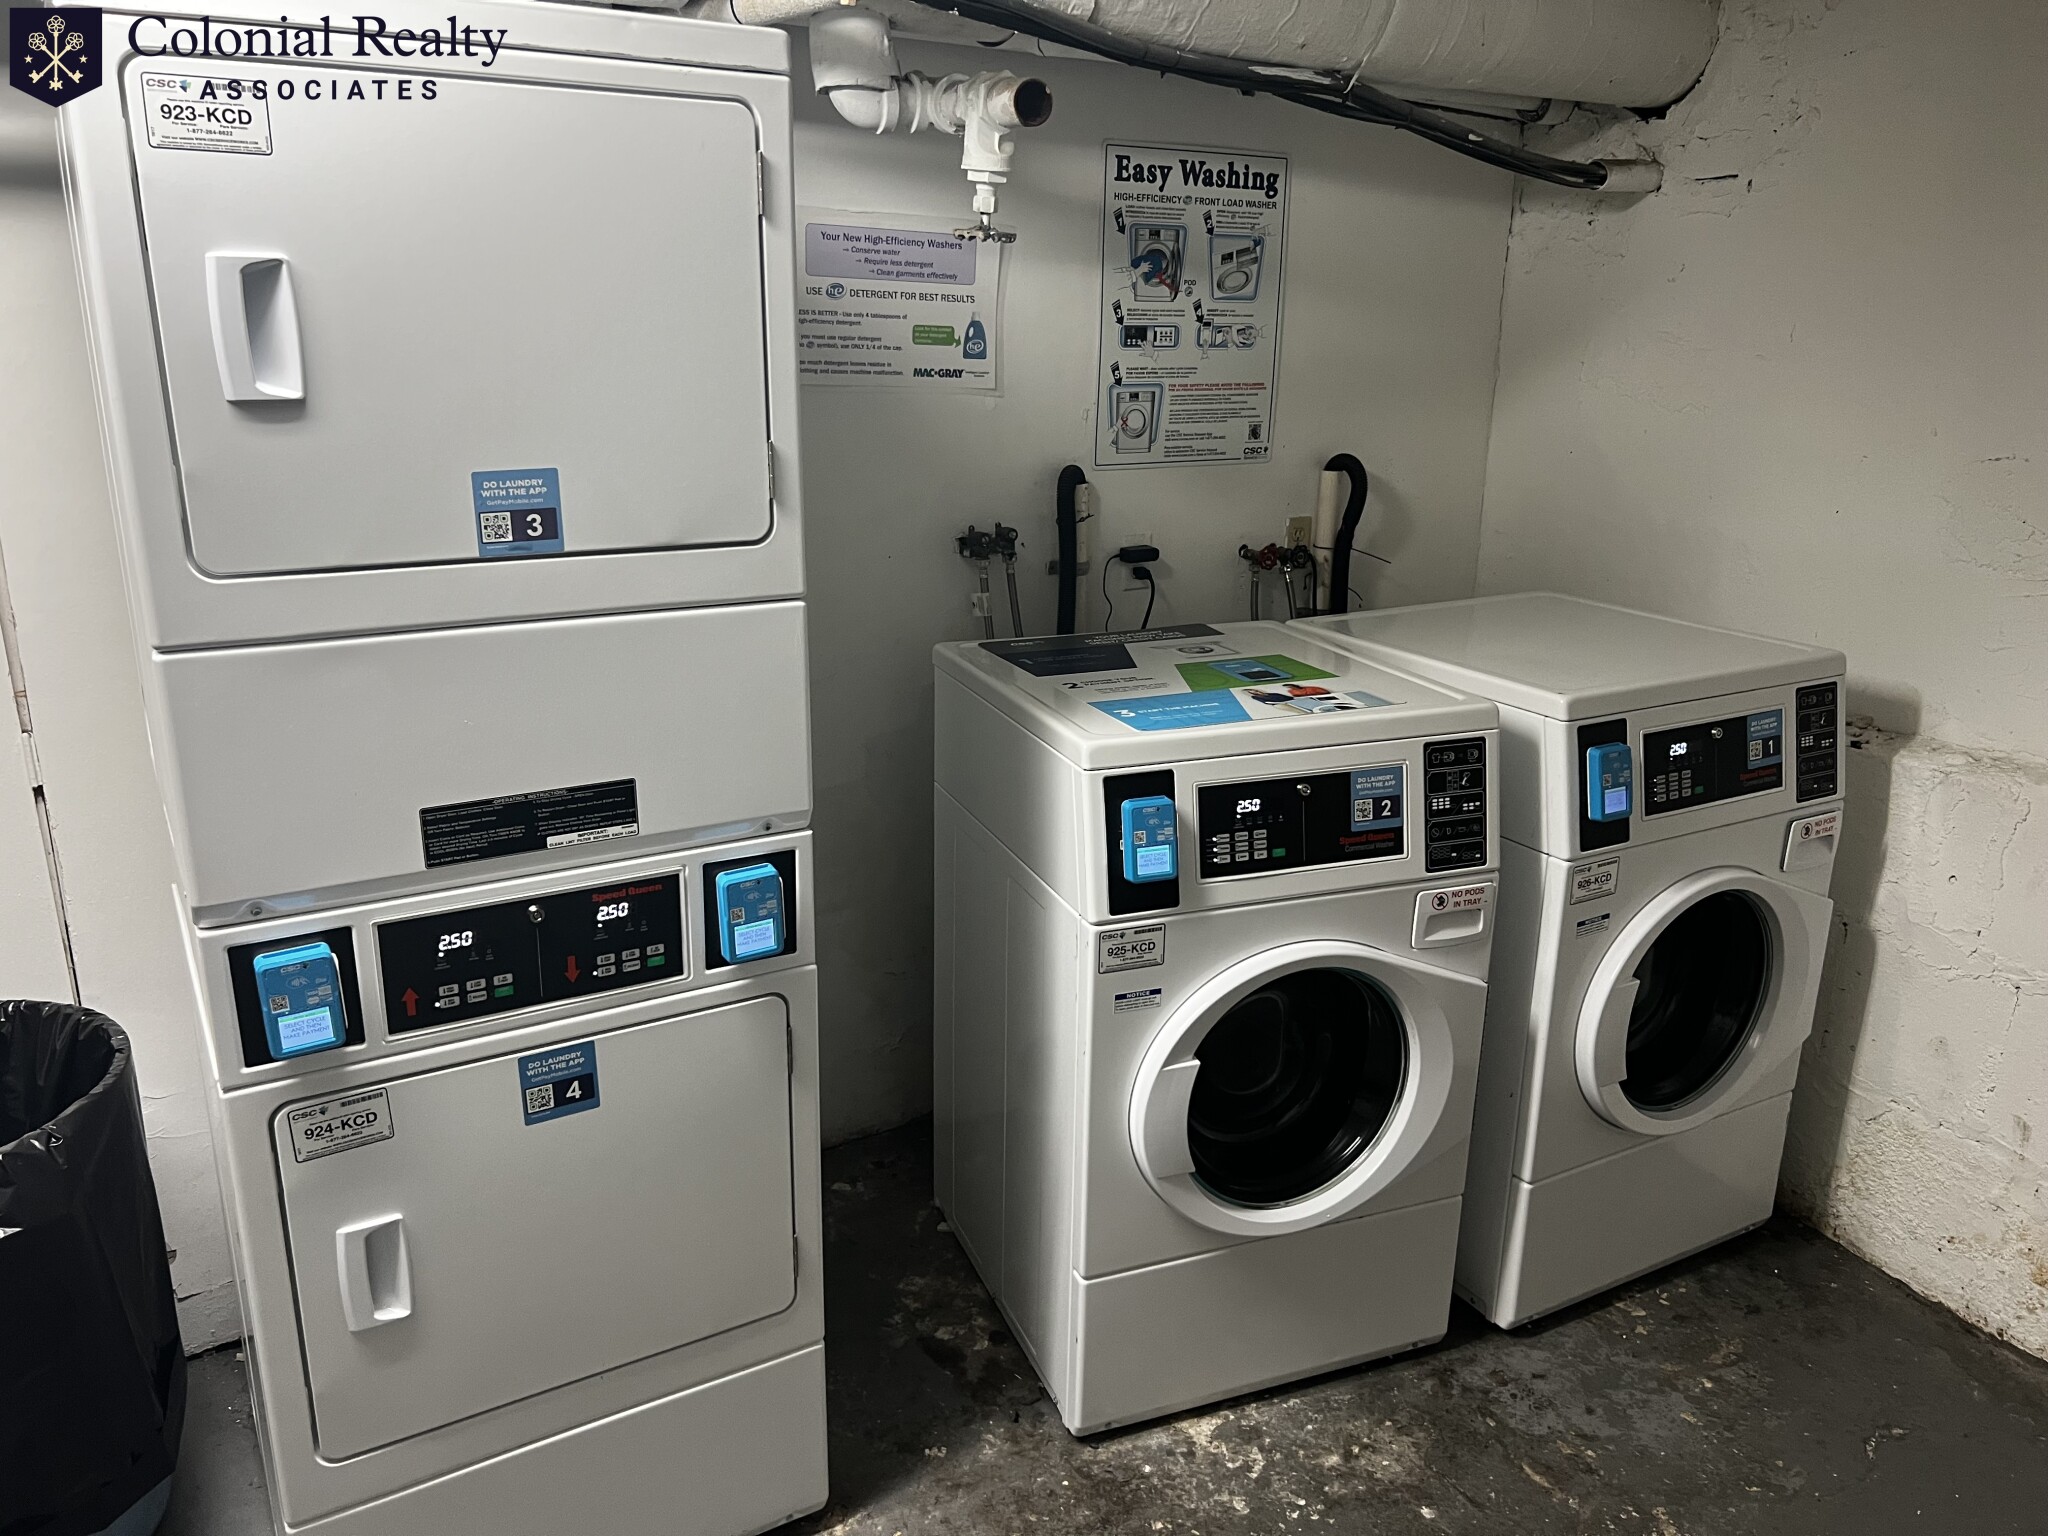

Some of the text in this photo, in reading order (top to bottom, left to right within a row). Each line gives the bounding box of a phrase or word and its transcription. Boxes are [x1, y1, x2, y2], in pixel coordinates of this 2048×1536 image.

[146, 78, 177, 88] CSC
[160, 103, 252, 125] 923-KCD
[1114, 154, 1280, 199] Easy Washing
[1114, 192, 1277, 209] HIGH-EFFICIENCY FRONT LOAD WASHER
[1117, 217, 1124, 226] 1
[1206, 219, 1213, 228] 2
[820, 231, 963, 250] Your New High-Efficiency Washers
[851, 246, 881, 254] Conserve
[864, 258, 889, 266] Require
[904, 260, 934, 269] detergent
[876, 268, 958, 281] Clean garments effectively
[806, 286, 823, 296] USE
[850, 288, 898, 300] DETERGENT
[900, 291, 916, 300] FOR
[919, 292, 939, 302] BEST
[941, 294, 975, 304] RESULTS
[1116, 309, 1121, 318] 3
[1114, 371, 1120, 379] 5
[1244, 447, 1262, 455] CSC
[483, 479, 544, 489] DO LAUNDRY
[481, 489, 506, 498] WITH
[508, 488, 526, 496] THE
[487, 498, 543, 506] GetPayMobile.com
[526, 513, 543, 536] 3
[1113, 709, 1136, 717] 3
[1768, 739, 1773, 754] 1
[1367, 774, 1394, 782] LAUNDRY
[1381, 800, 1391, 816] 2
[577, 830, 608, 838] IMPORTANT:
[1339, 835, 1366, 845] Speed
[1345, 843, 1375, 852] Commercial
[1577, 872, 1612, 889] 926-KCD
[592, 884, 662, 902] Speed Queen
[1465, 887, 1485, 896] PODS
[1463, 898, 1481, 906] TRAY
[1107, 941, 1156, 957] 925-KCD
[1126, 990, 1151, 998] NOTICE
[542, 1051, 582, 1065] LAUNDRY
[526, 1058, 584, 1076] WITH THE APP
[566, 1080, 582, 1099] 4
[292, 1110, 317, 1120] CSC
[304, 1112, 378, 1140] 924-KCD
